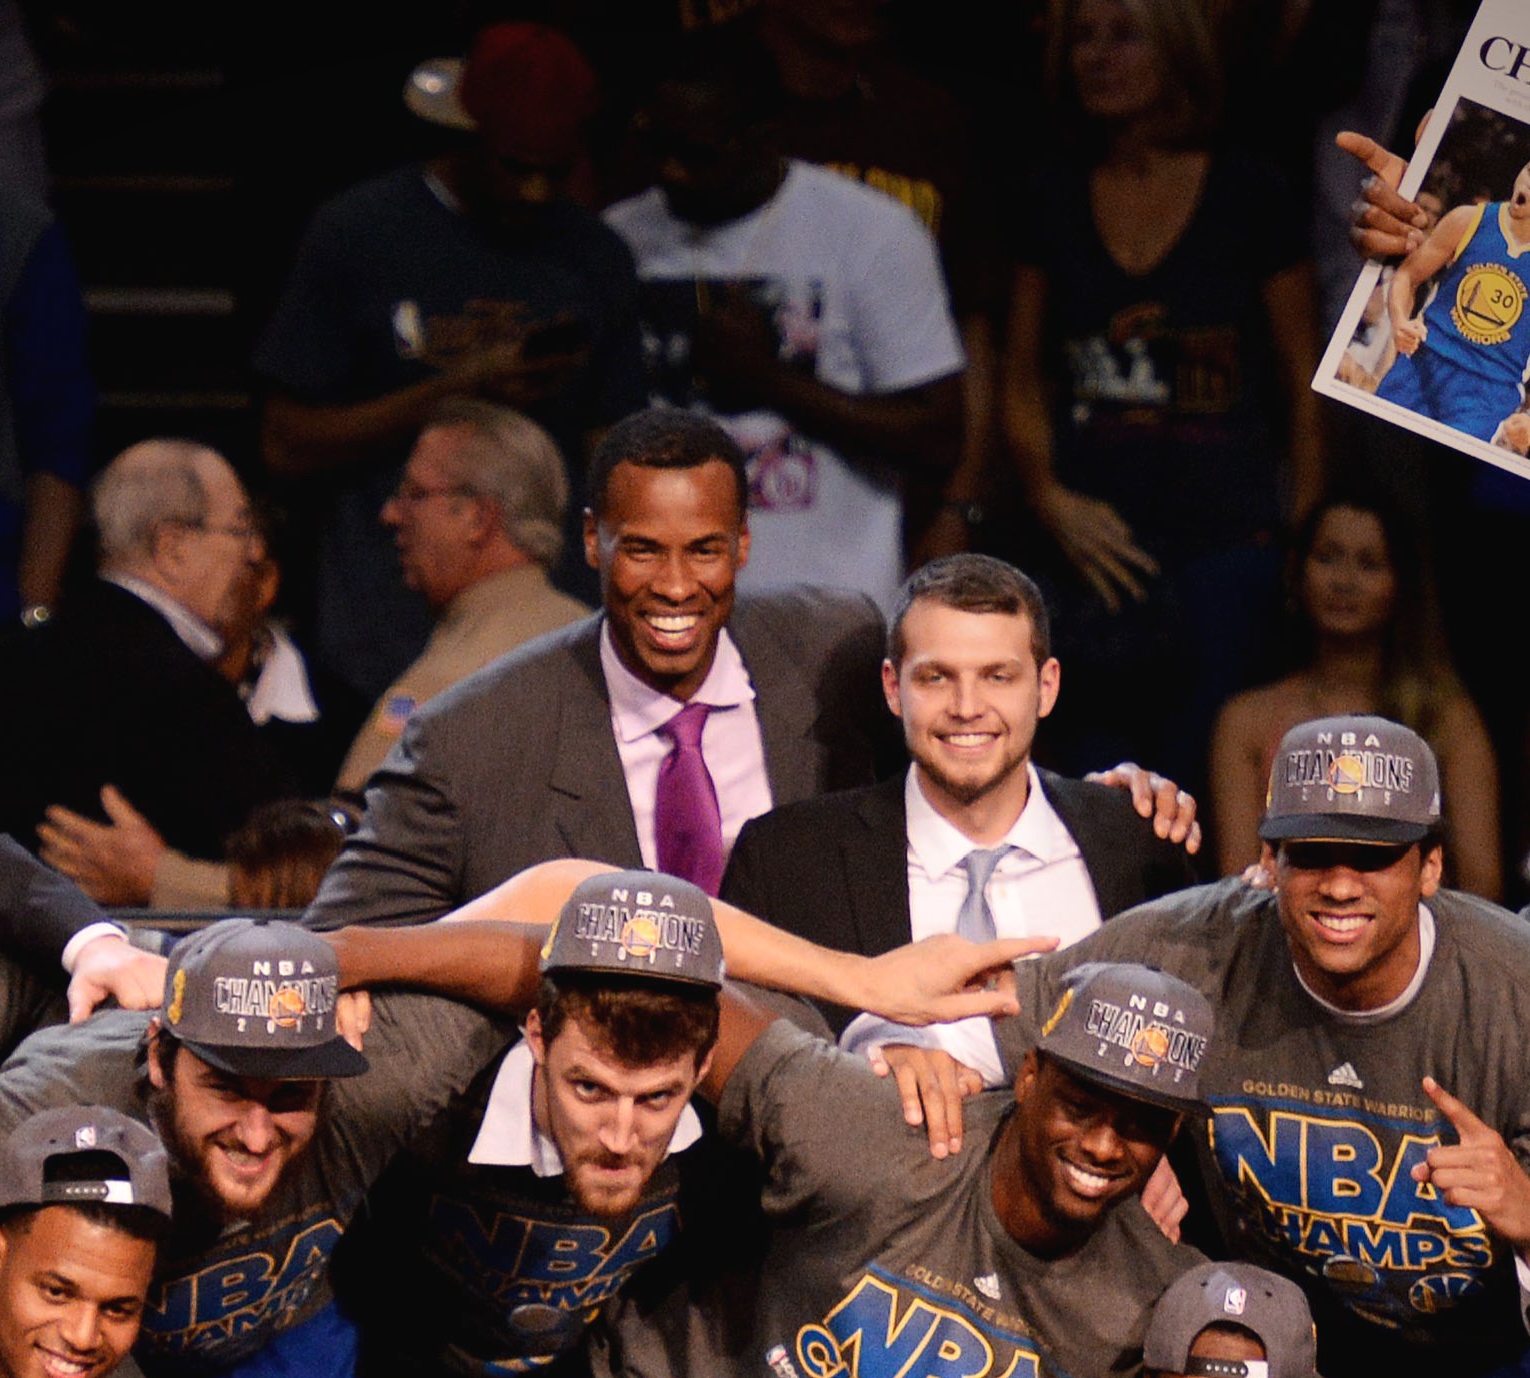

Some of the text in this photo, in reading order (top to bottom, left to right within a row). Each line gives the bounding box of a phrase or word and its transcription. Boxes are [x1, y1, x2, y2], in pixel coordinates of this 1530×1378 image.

[1490, 289, 1514, 308] 30
[1317, 731, 1381, 748] NBA
[253, 960, 314, 976] NBA
[1243, 1079, 1436, 1124] GOLDEN STATE WARRIOR
[1208, 1107, 1486, 1234] NBA
[424, 1194, 684, 1284] NBA
[1267, 1205, 1493, 1271] HAMPS
